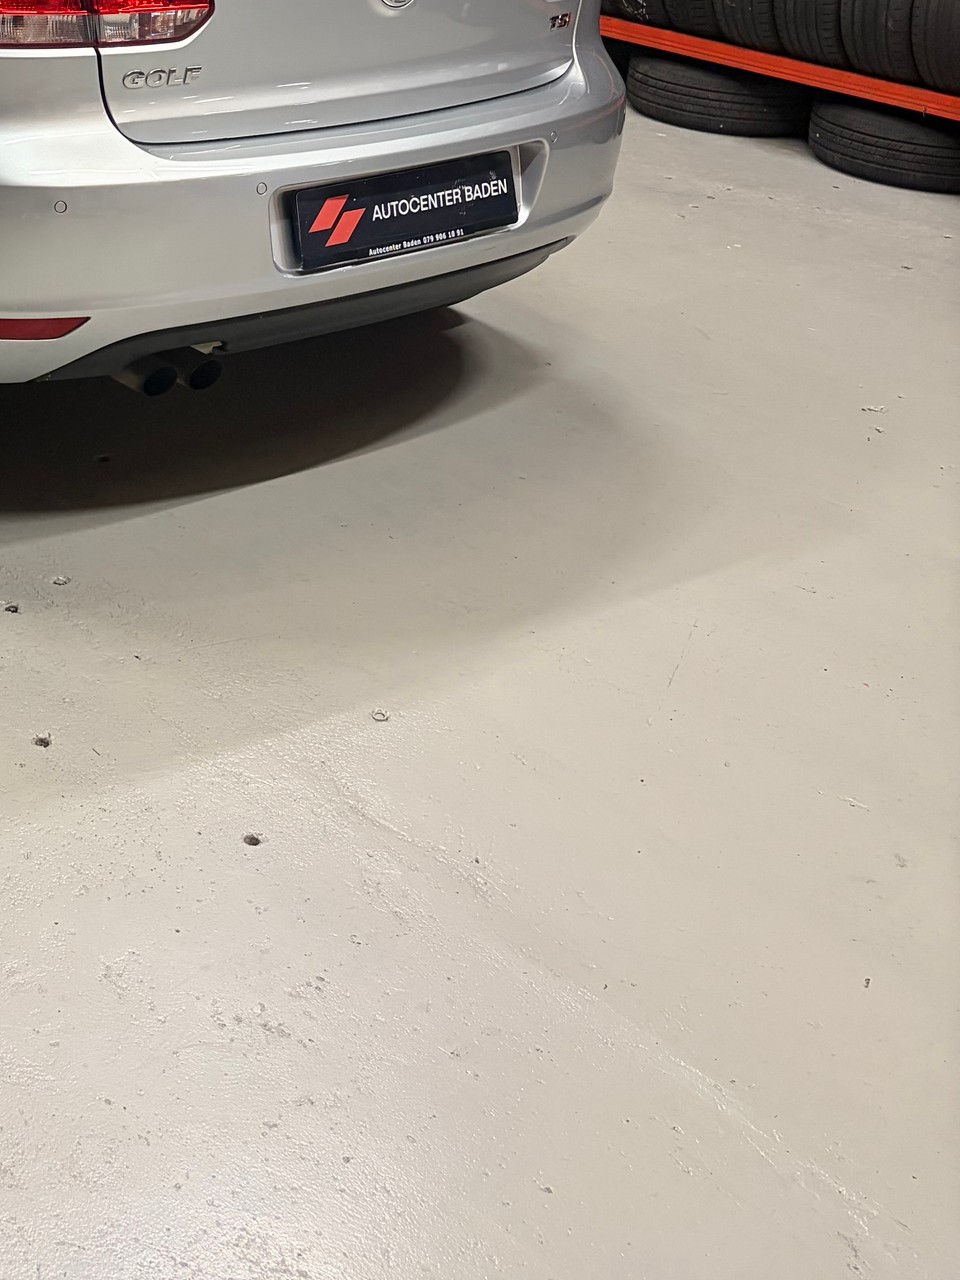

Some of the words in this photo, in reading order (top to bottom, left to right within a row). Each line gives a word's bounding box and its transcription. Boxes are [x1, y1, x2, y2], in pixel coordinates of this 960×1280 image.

[550, 12, 572, 30] TSI
[122, 64, 202, 90] GOLF
[372, 188, 462, 222] AUTOCENTER
[464, 178, 508, 202] BADEN
[368, 243, 402, 256] Autocenter
[402, 239, 422, 249] Baden
[422, 235, 434, 244] 079
[447, 230, 456, 239] 10
[456, 228, 464, 236] 91
